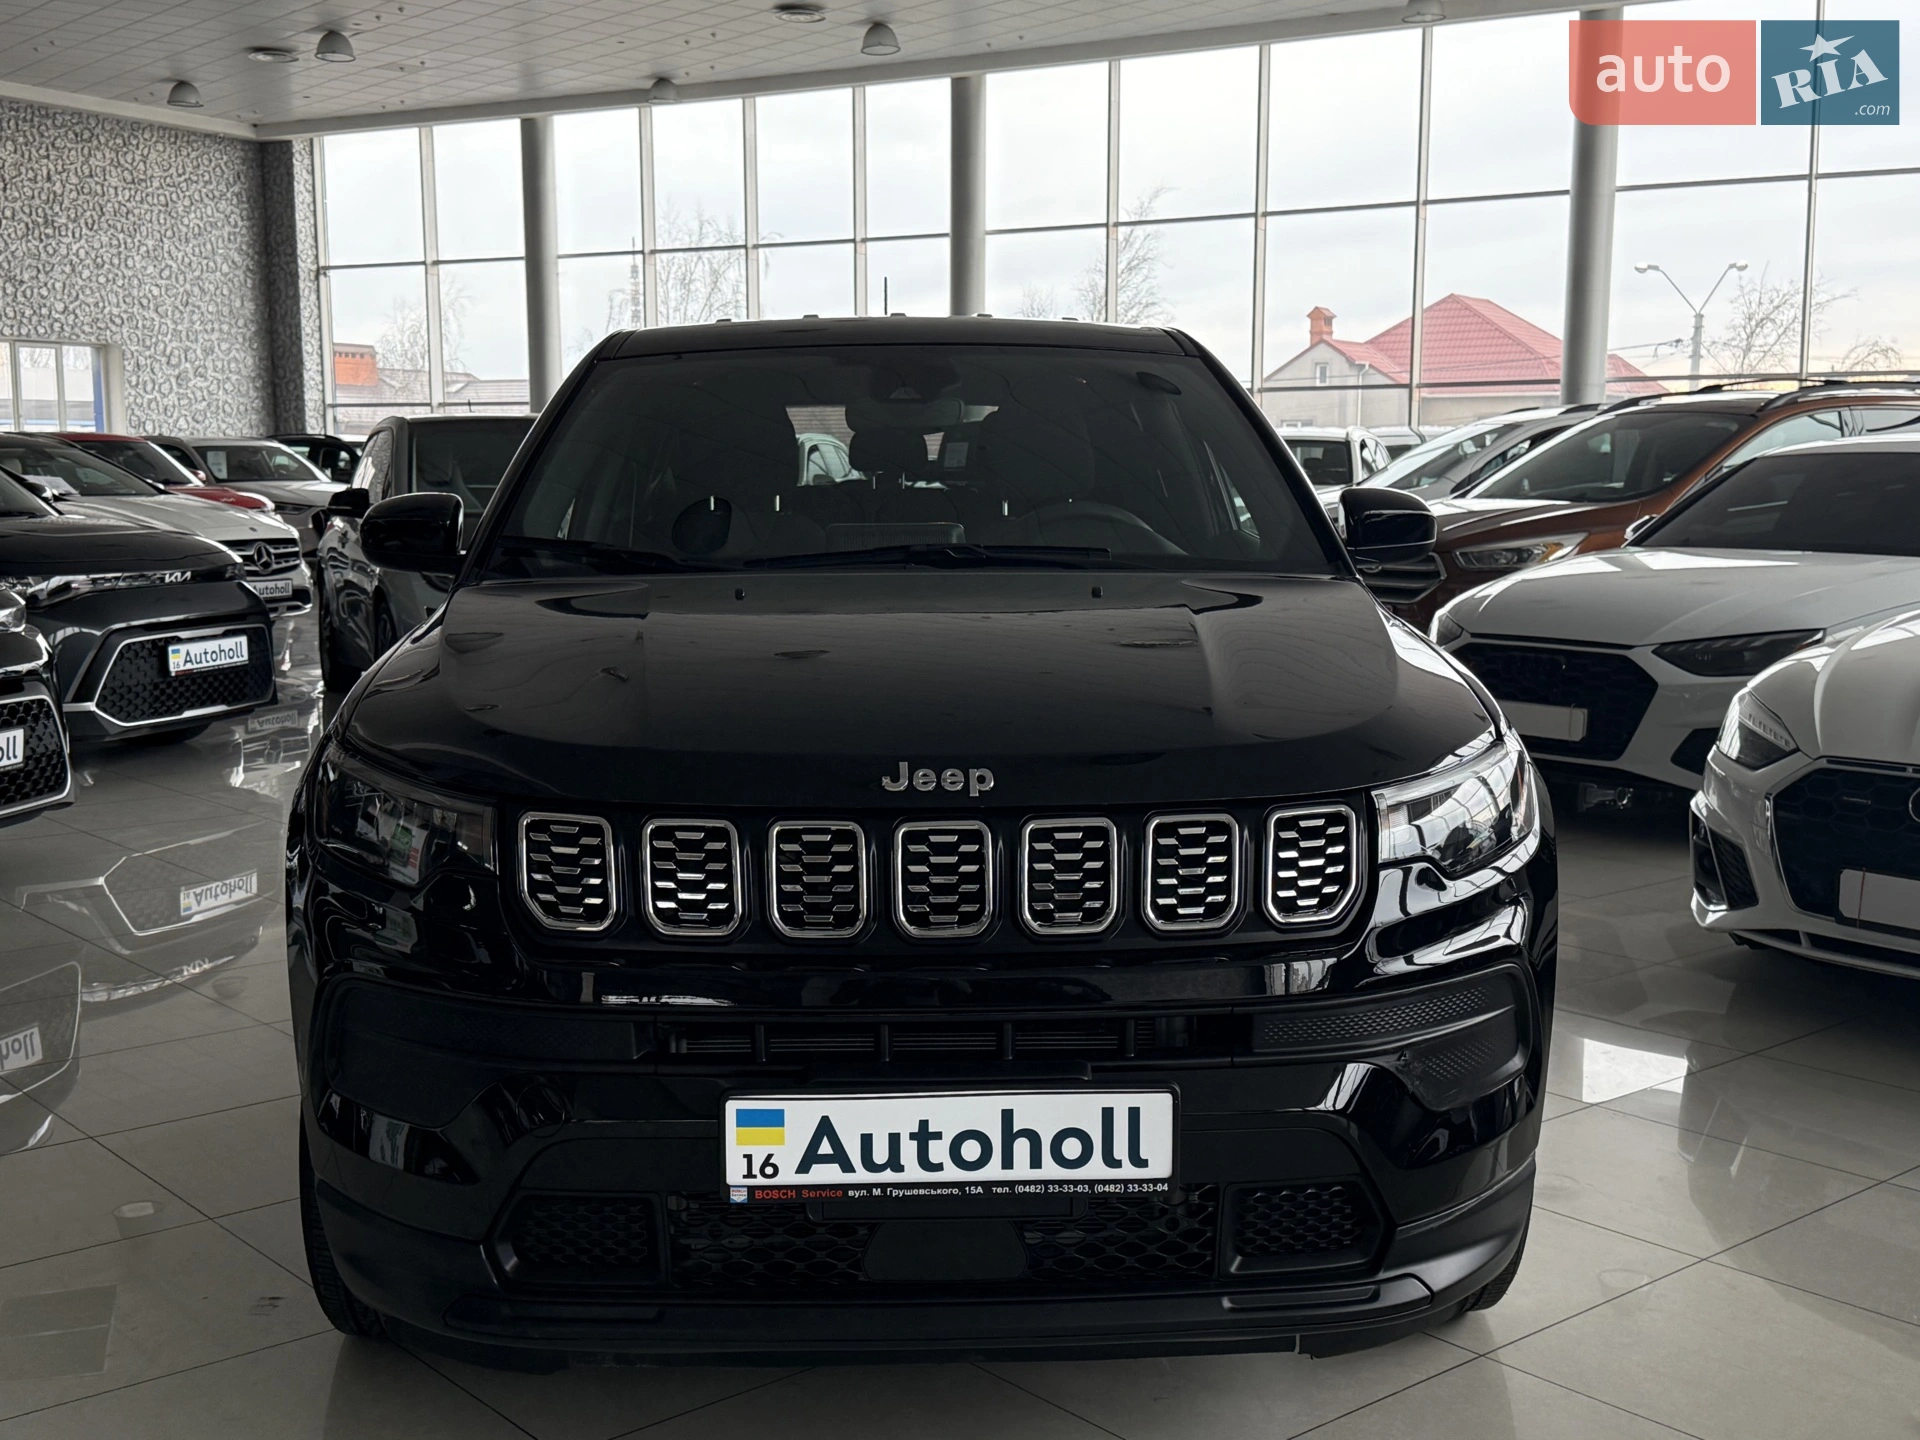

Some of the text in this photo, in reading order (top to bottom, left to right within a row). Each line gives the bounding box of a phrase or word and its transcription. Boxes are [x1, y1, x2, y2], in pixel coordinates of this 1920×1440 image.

[172, 661, 181, 670] 16
[183, 640, 244, 667] Autoholl
[882, 762, 994, 797] Jeep
[742, 1106, 1149, 1180] 16 Autoholl
[754, 1189, 796, 1199] BOSCH
[801, 1188, 843, 1198] Service
[848, 1189, 870, 1198] вул.
[886, 1187, 962, 1197] Грушевського,
[992, 1186, 1012, 1194] тел.
[1014, 1184, 1045, 1194] (0482)
[1047, 1184, 1092, 1194] 33-33-03,
[1094, 1183, 1125, 1194] (0482)
[1127, 1183, 1169, 1192] 33-33-04
